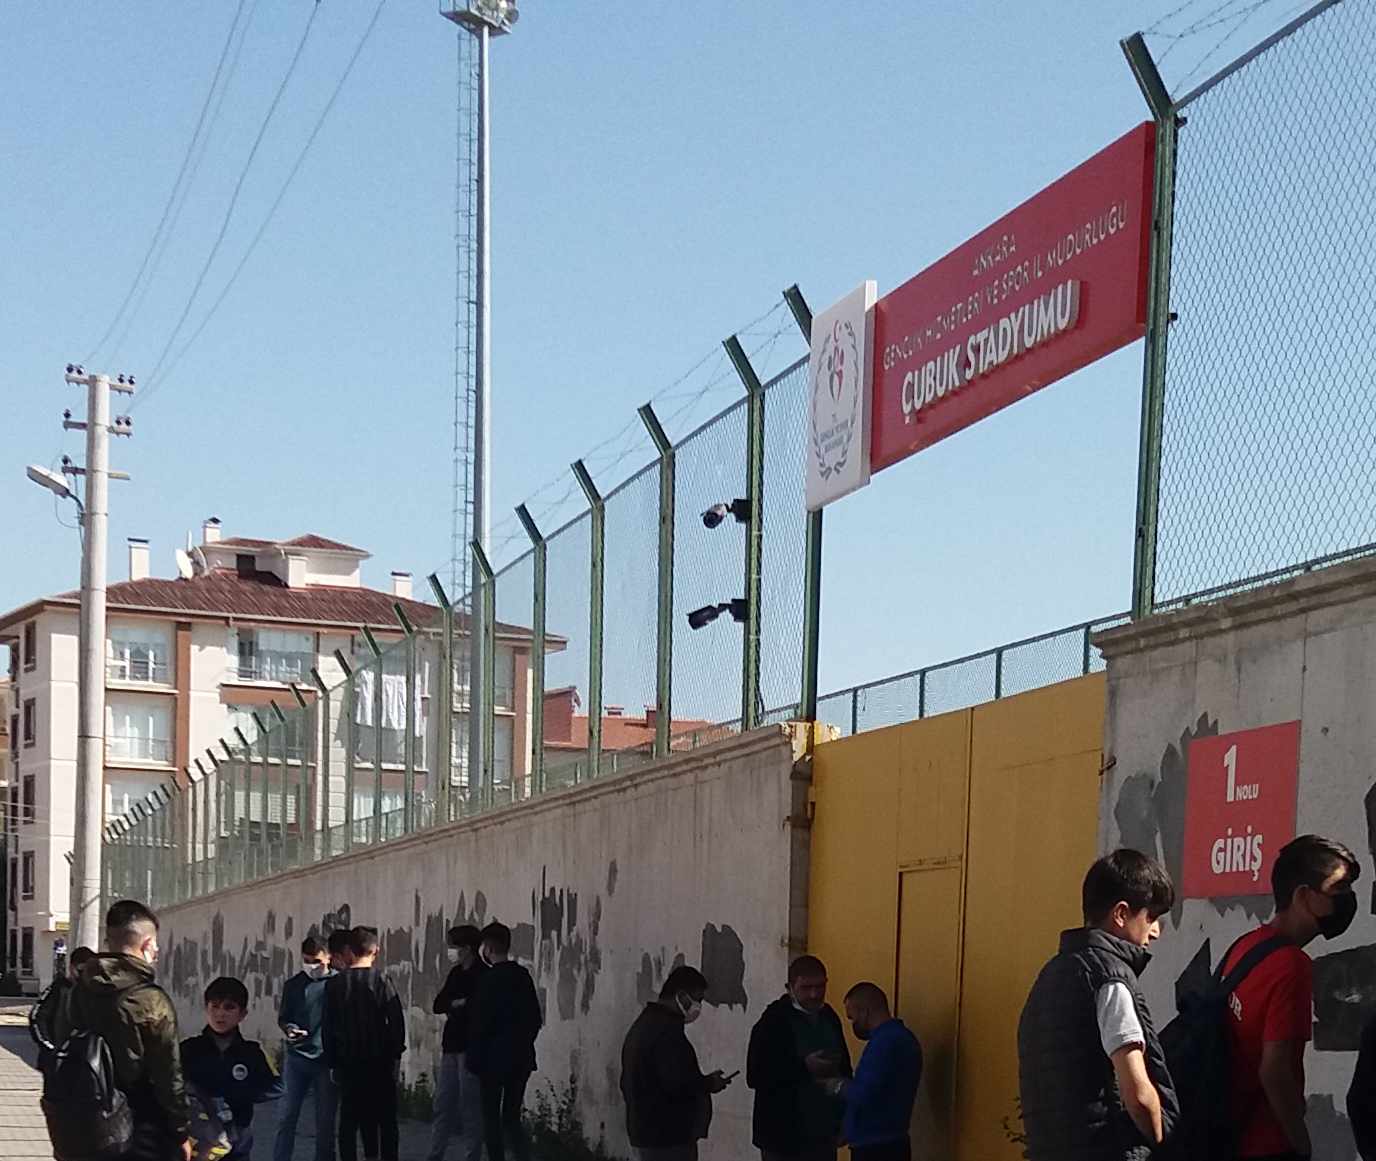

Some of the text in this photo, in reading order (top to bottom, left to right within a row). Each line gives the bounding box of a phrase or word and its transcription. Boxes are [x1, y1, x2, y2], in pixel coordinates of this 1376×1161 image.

[972, 234, 1016, 276] ANKARA
[986, 279, 999, 305] VE
[1001, 261, 1030, 300] SPOR
[901, 278, 1074, 424] ÇUBUK STADYUMU
[1223, 744, 1260, 802] 1 NOLU
[1211, 825, 1263, 881] GİRİŞ
